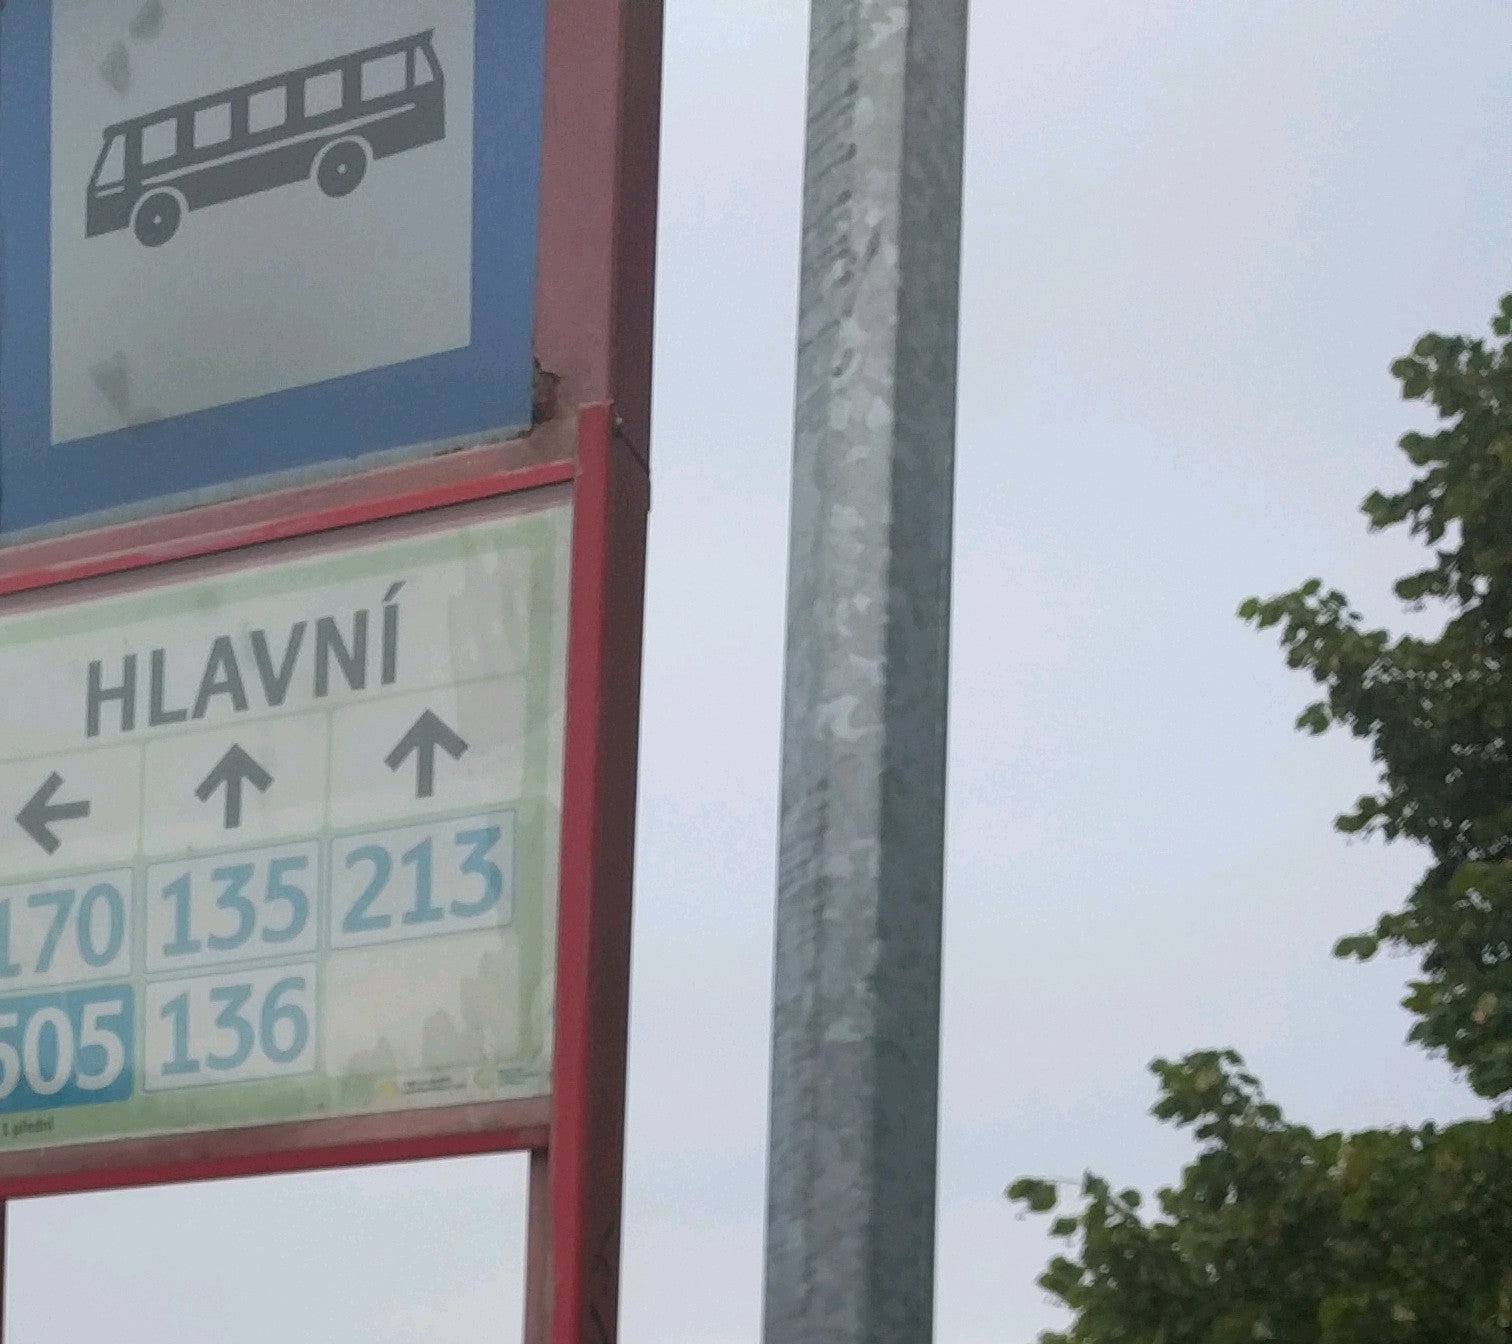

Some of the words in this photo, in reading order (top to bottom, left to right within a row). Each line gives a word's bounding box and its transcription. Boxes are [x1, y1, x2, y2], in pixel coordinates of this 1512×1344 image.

[84, 582, 406, 737] HLAVNÍ
[162, 855, 311, 957] 135
[342, 826, 504, 933] 213
[162, 976, 309, 1077] 136
